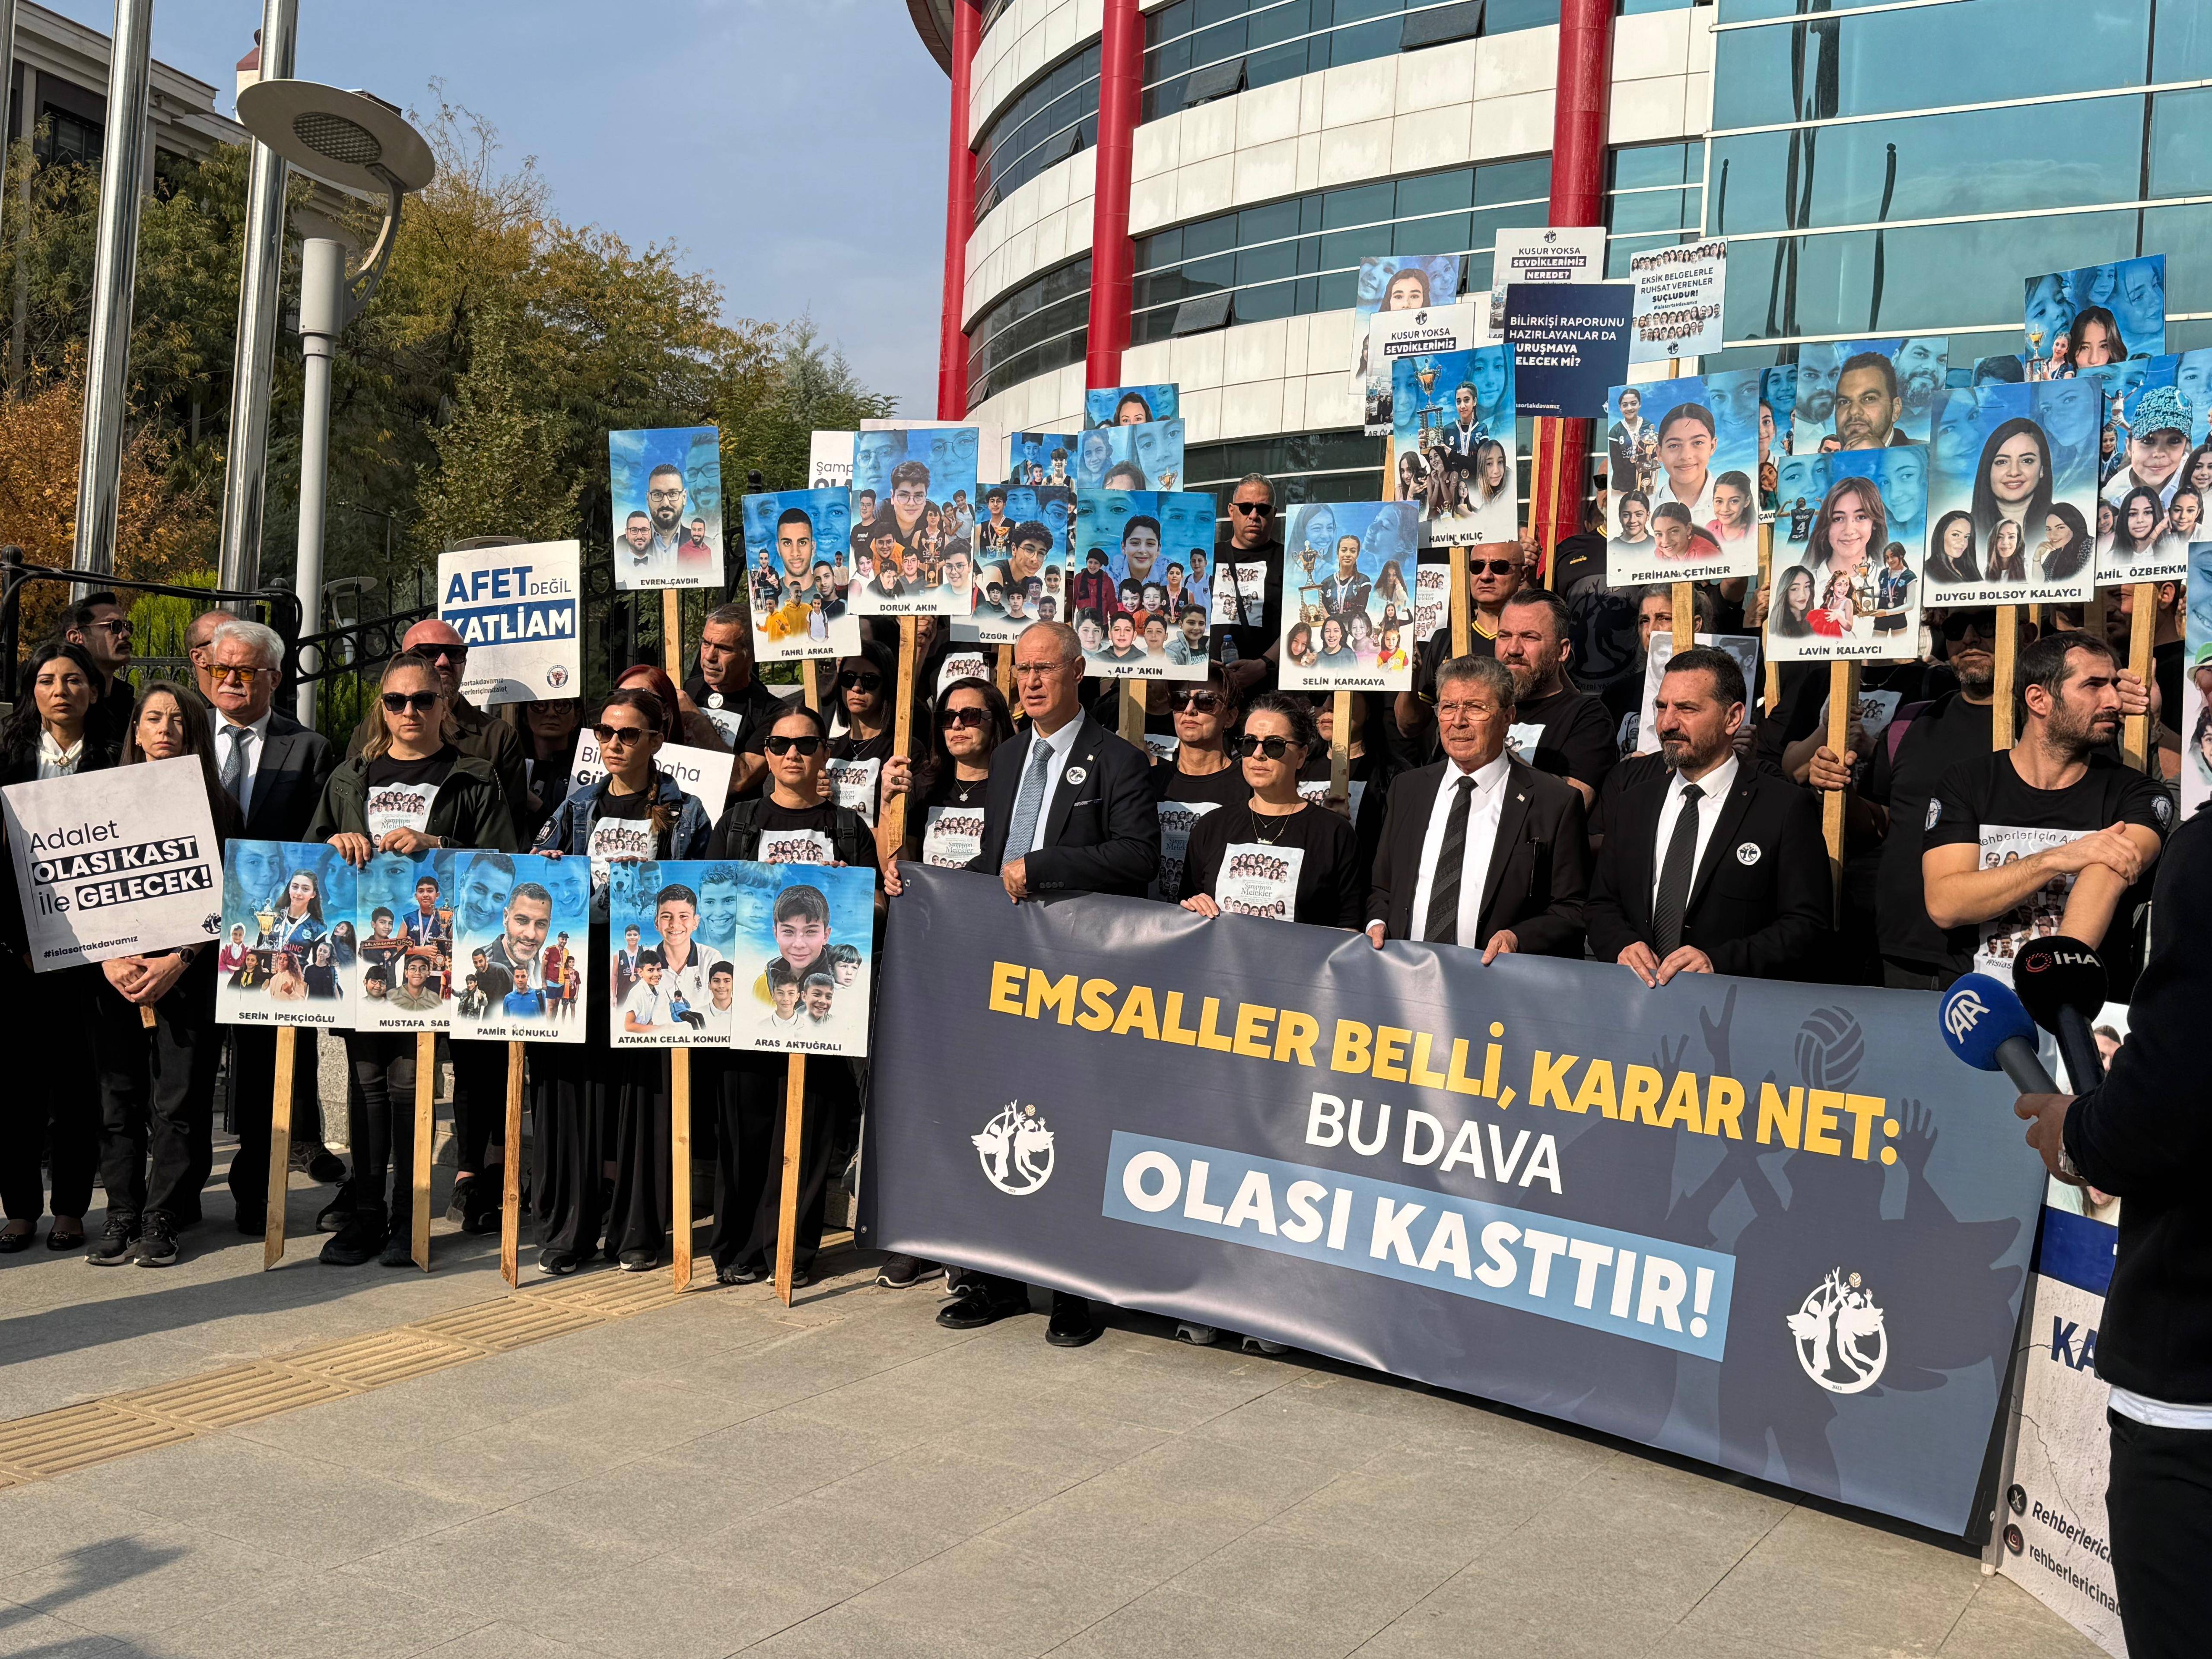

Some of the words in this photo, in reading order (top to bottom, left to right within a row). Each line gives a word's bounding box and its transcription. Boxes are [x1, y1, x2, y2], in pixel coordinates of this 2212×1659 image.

[1513, 256, 1585, 267] SEVDİKLERİMİZ
[1641, 274, 1662, 284] EKSİK
[1665, 267, 1713, 281] BELGELERLE
[1641, 283, 1670, 294] RUHSAT
[1672, 278, 1713, 289] VERENLER
[1652, 289, 1698, 302] SUÇLUDUR!
[1510, 314, 1558, 328] BİLİRKİŞİ
[1560, 318, 1624, 327] RAPORUNU
[1392, 330, 1419, 340] KUSUR
[1422, 328, 1450, 337] YOKSA
[1510, 330, 1598, 340] HAZIRLAYANLAR
[1602, 331, 1616, 340] DA
[1386, 340, 1454, 353] SEVDİKLERİMİZ
[1516, 343, 1577, 355] URUŞMAYA
[1516, 356, 1558, 366] ELECEK
[1561, 355, 1581, 366] Mİ?
[1429, 533, 1455, 543] HAVİN
[1460, 532, 1483, 542] KILIÇ
[1632, 569, 1677, 581] PERİHAN
[1685, 566, 1731, 579] ÇETİNER
[445, 566, 533, 604] AFET
[530, 578, 571, 595] DEĞİL
[671, 578, 699, 586] ÇAVDIR
[1936, 592, 1976, 602] DUYGU
[1979, 591, 2026, 601] BOLSOY
[2030, 588, 2082, 599] KALAYCI
[980, 632, 1007, 640] ÖZGÜR
[782, 648, 803, 656] FAHRİ
[1799, 645, 1830, 655] LAVİN
[1837, 645, 1881, 655] KALAYCI
[1303, 677, 1328, 685] SELİN
[30, 820, 120, 853] Adalet
[33, 857, 116, 883] OLASI
[122, 838, 196, 868] KAST
[78, 866, 210, 908] GELECEK!
[2054, 951, 2101, 967] İHA
[238, 1011, 268, 1020] SERİN
[275, 1012, 335, 1023] İPEKÇİOĞLU
[1951, 998, 1990, 1044] AA
[477, 1027, 505, 1036] PAMİR
[512, 1029, 558, 1037] KONUKLU
[618, 1036, 657, 1044] ATAKAN
[755, 1039, 780, 1048] ARAS
[989, 961, 1319, 1066] EMSALLER
[1330, 1019, 1516, 1110] BELLİ,
[1529, 1050, 1745, 1140] KARAR
[1757, 1082, 1899, 1165] NET:
[1306, 1092, 1391, 1156] BU
[1402, 1109, 1562, 1194] DAVA
[1123, 1151, 1352, 1250] OLASI
[1369, 1197, 1715, 1338] KASTTIR!
